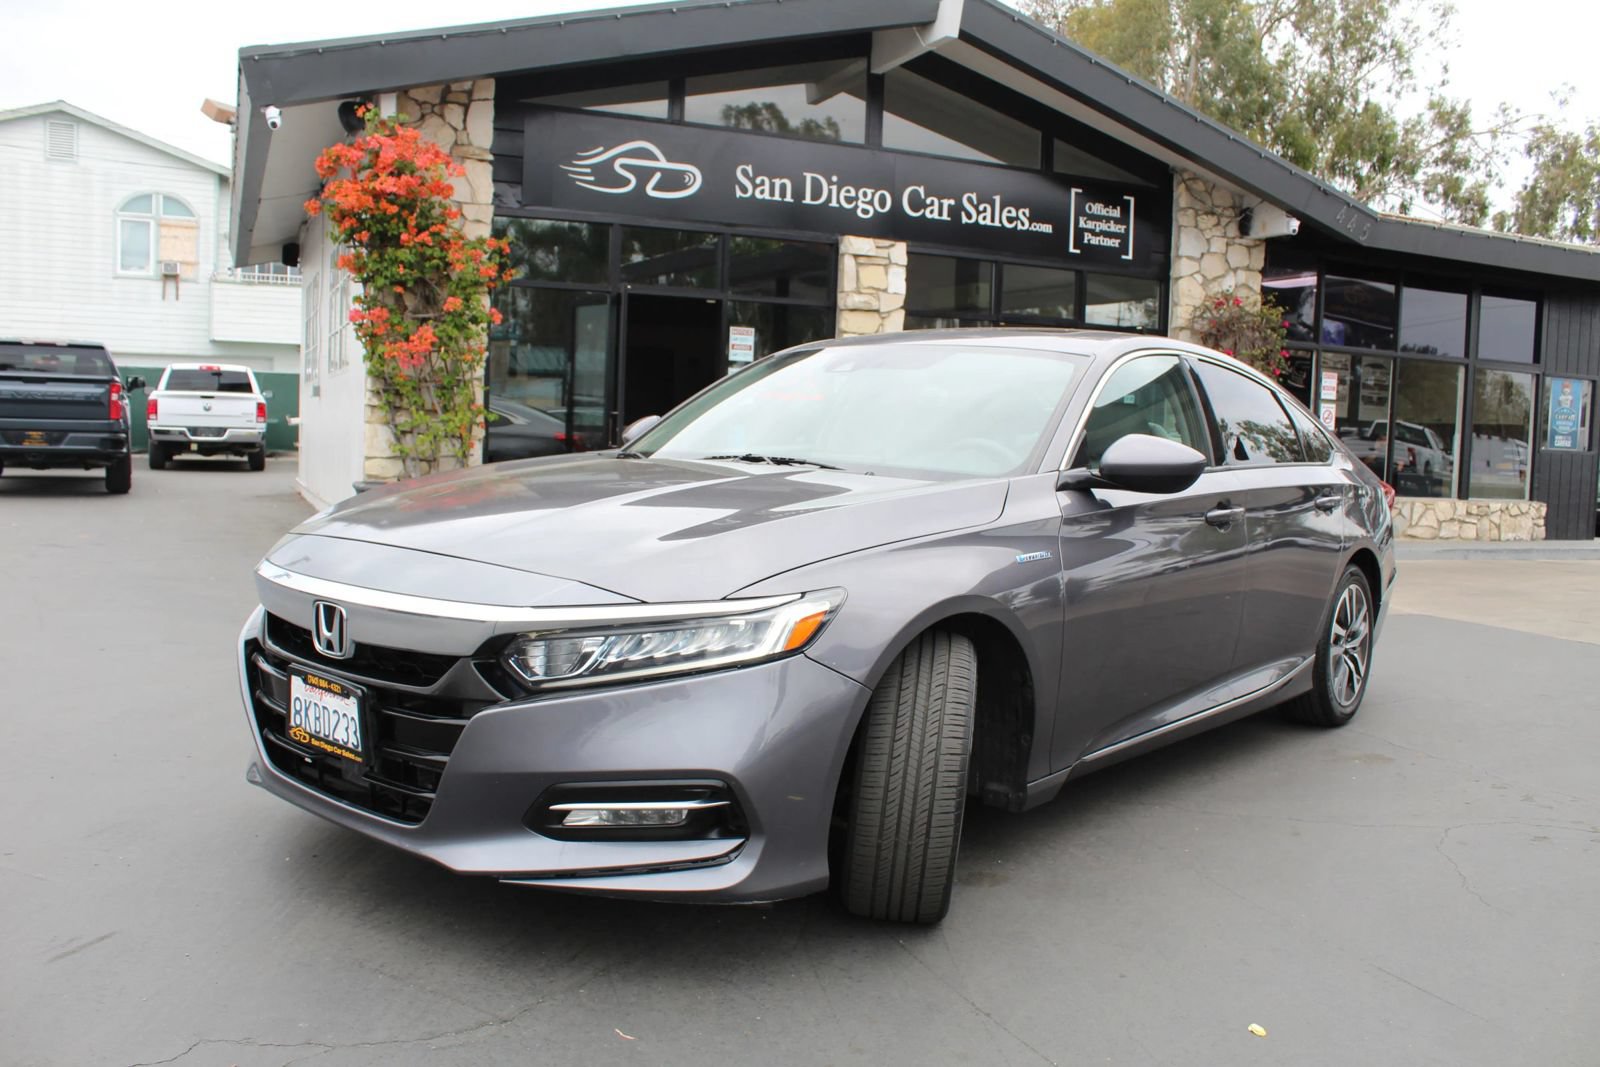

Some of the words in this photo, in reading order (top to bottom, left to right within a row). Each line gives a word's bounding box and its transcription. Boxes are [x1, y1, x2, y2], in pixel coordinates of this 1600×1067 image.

[734, 164, 794, 203] San
[801, 171, 892, 220] Diego
[901, 185, 956, 221] Car
[1085, 202, 1121, 218] Official
[1078, 216, 1127, 234] Karpicker
[1335, 205, 1371, 241] 445
[1083, 232, 1121, 248] Partner
[293, 696, 360, 750] 8KBD233
[320, 741, 334, 753] Diego
